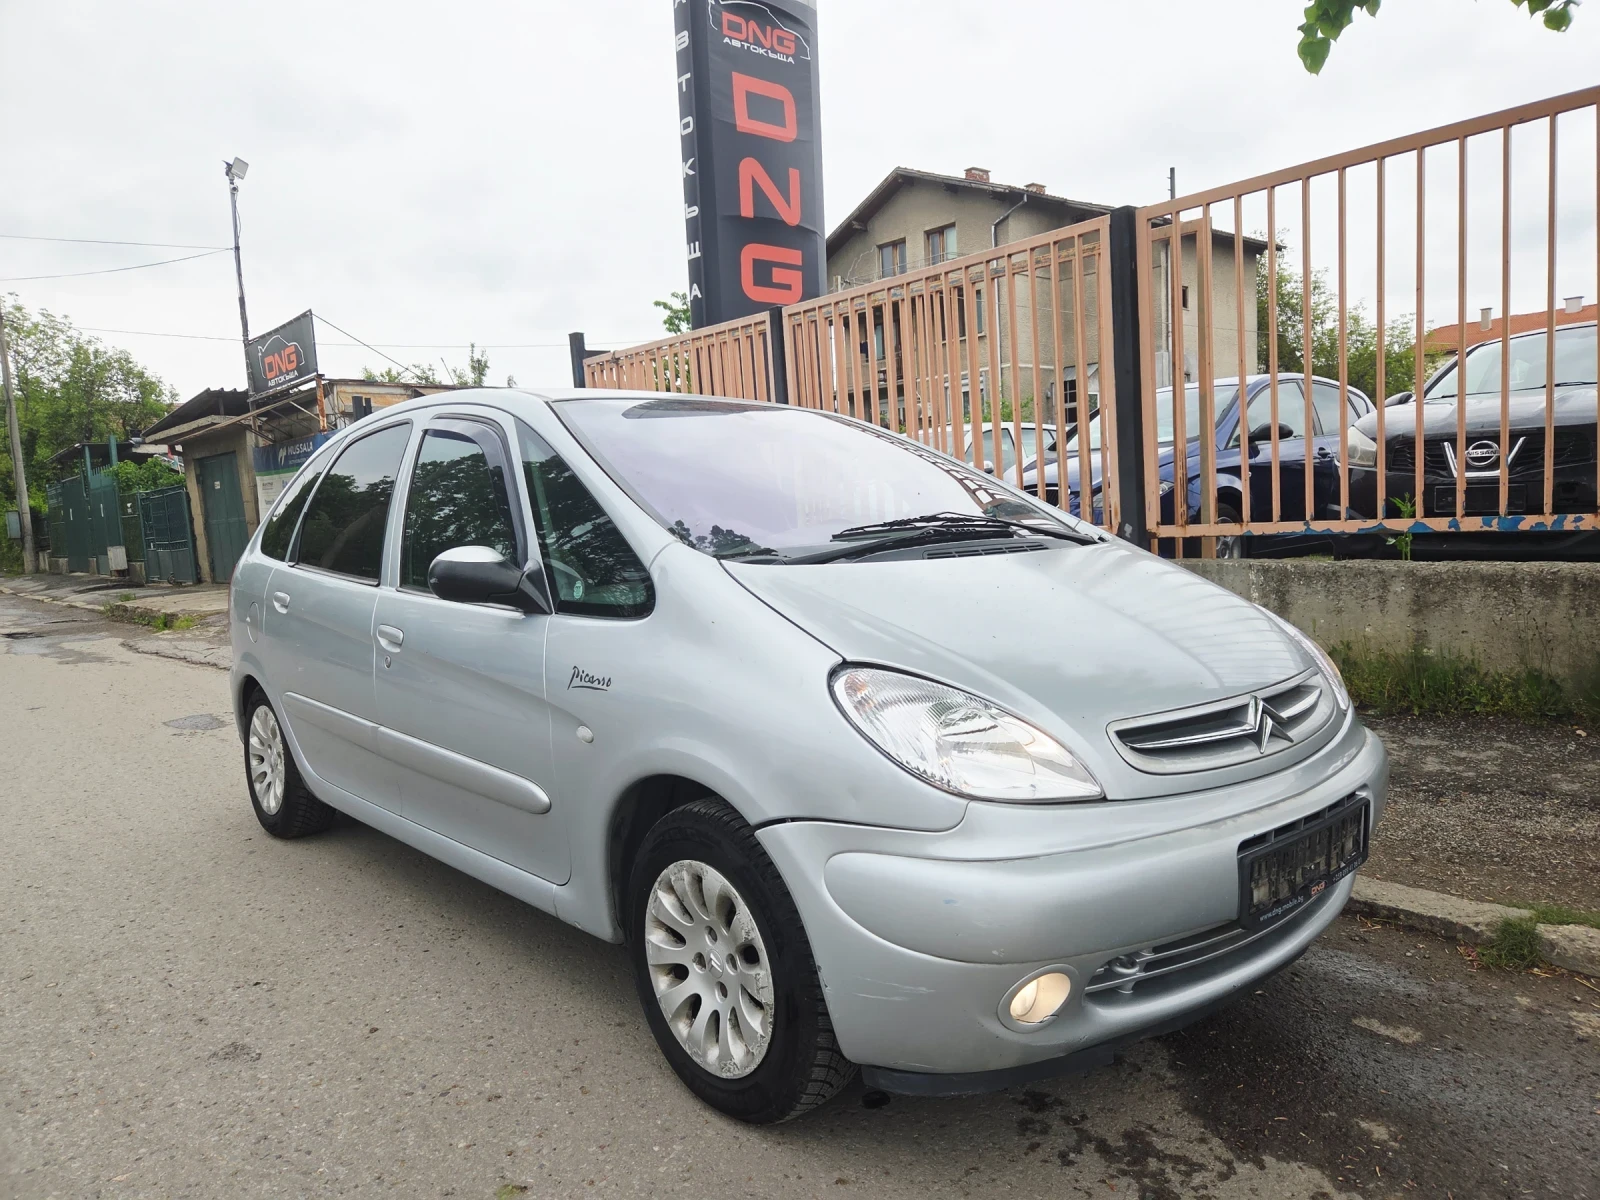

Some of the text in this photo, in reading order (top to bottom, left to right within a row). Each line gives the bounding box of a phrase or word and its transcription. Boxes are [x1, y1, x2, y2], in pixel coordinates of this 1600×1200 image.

[721, 11, 796, 55] DNG
[723, 37, 795, 64] АВТОКЪЩА
[731, 71, 803, 305] DNG
[264, 345, 297, 379] DNG
[567, 665, 612, 691] Picasso
